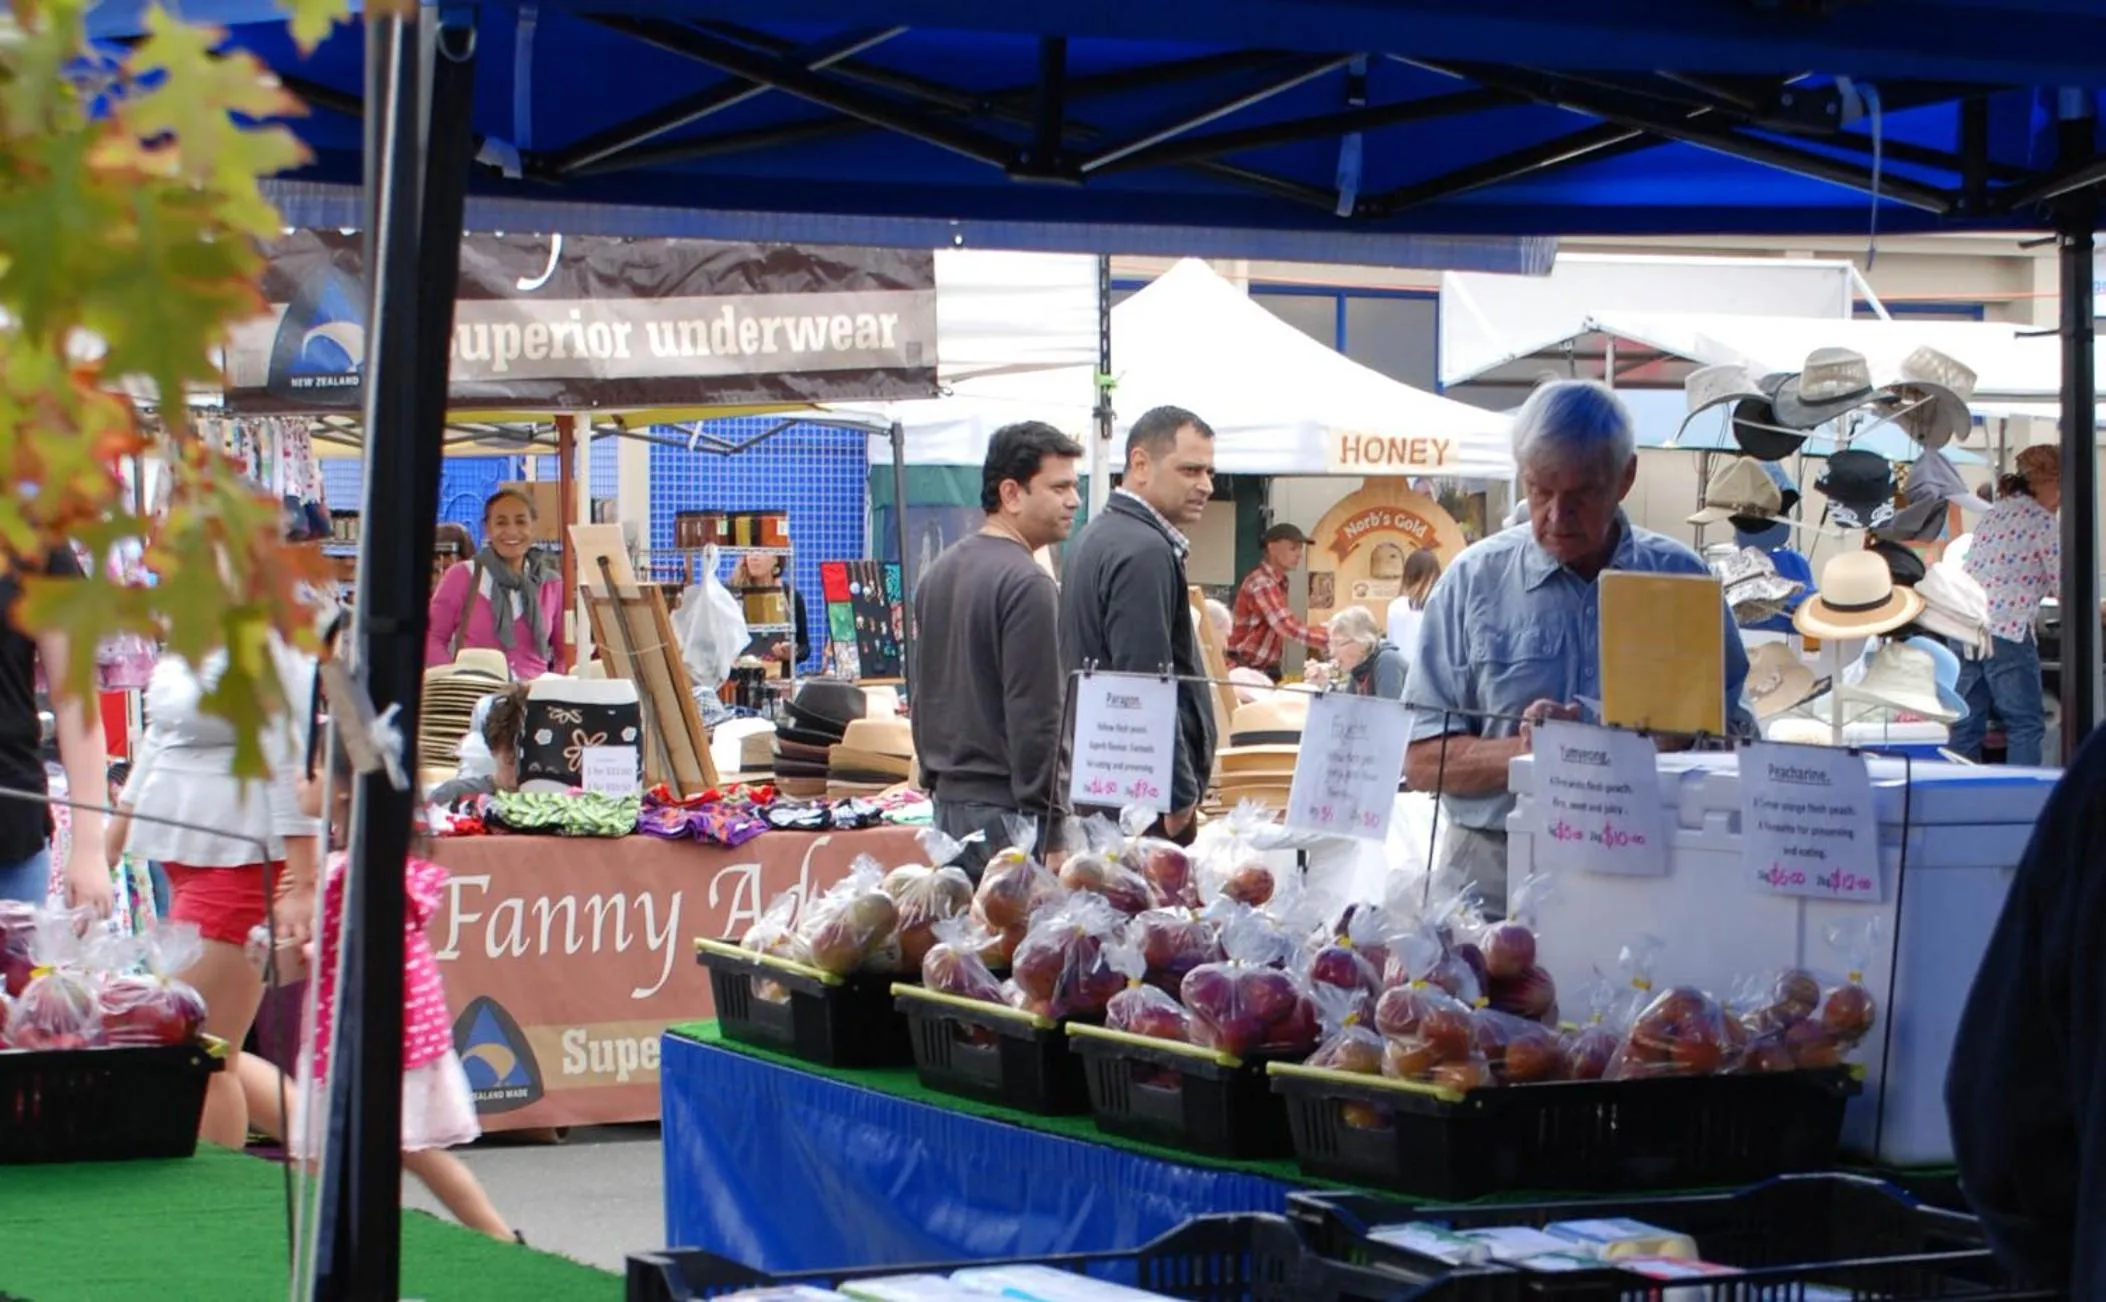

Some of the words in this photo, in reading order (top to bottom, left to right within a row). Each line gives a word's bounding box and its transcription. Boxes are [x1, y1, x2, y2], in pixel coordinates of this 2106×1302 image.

[452, 309, 632, 372] uperior
[646, 305, 898, 358] underwear
[290, 377, 314, 388] NEW
[315, 375, 360, 388] ZEALAND
[1340, 435, 1450, 466] HONEY
[1343, 511, 1391, 538] Norb's
[1394, 513, 1428, 538] Gold
[435, 874, 682, 999] Fanny
[562, 1028, 661, 1082] Supe
[505, 1087, 528, 1099] MADE
